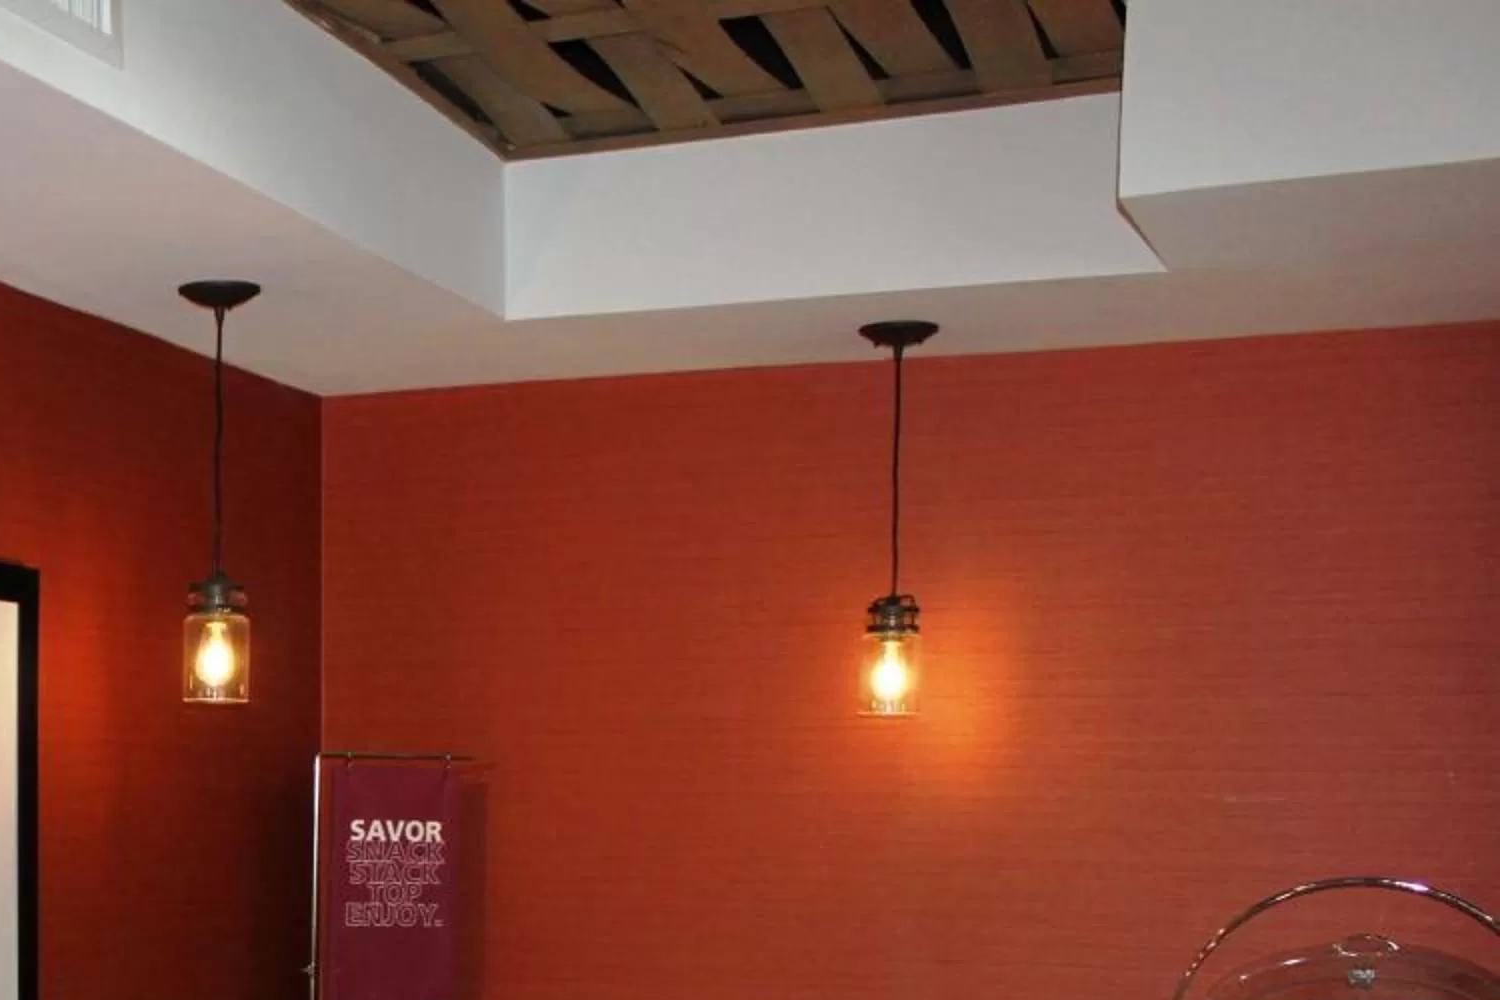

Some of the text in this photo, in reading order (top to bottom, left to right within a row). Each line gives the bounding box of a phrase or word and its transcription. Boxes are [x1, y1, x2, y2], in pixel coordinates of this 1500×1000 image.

[350, 818, 443, 843] SAVOR
[347, 840, 445, 864] SNACK
[349, 861, 441, 884] STACK
[367, 881, 422, 904] TOP
[345, 902, 444, 927] ENJOY.
